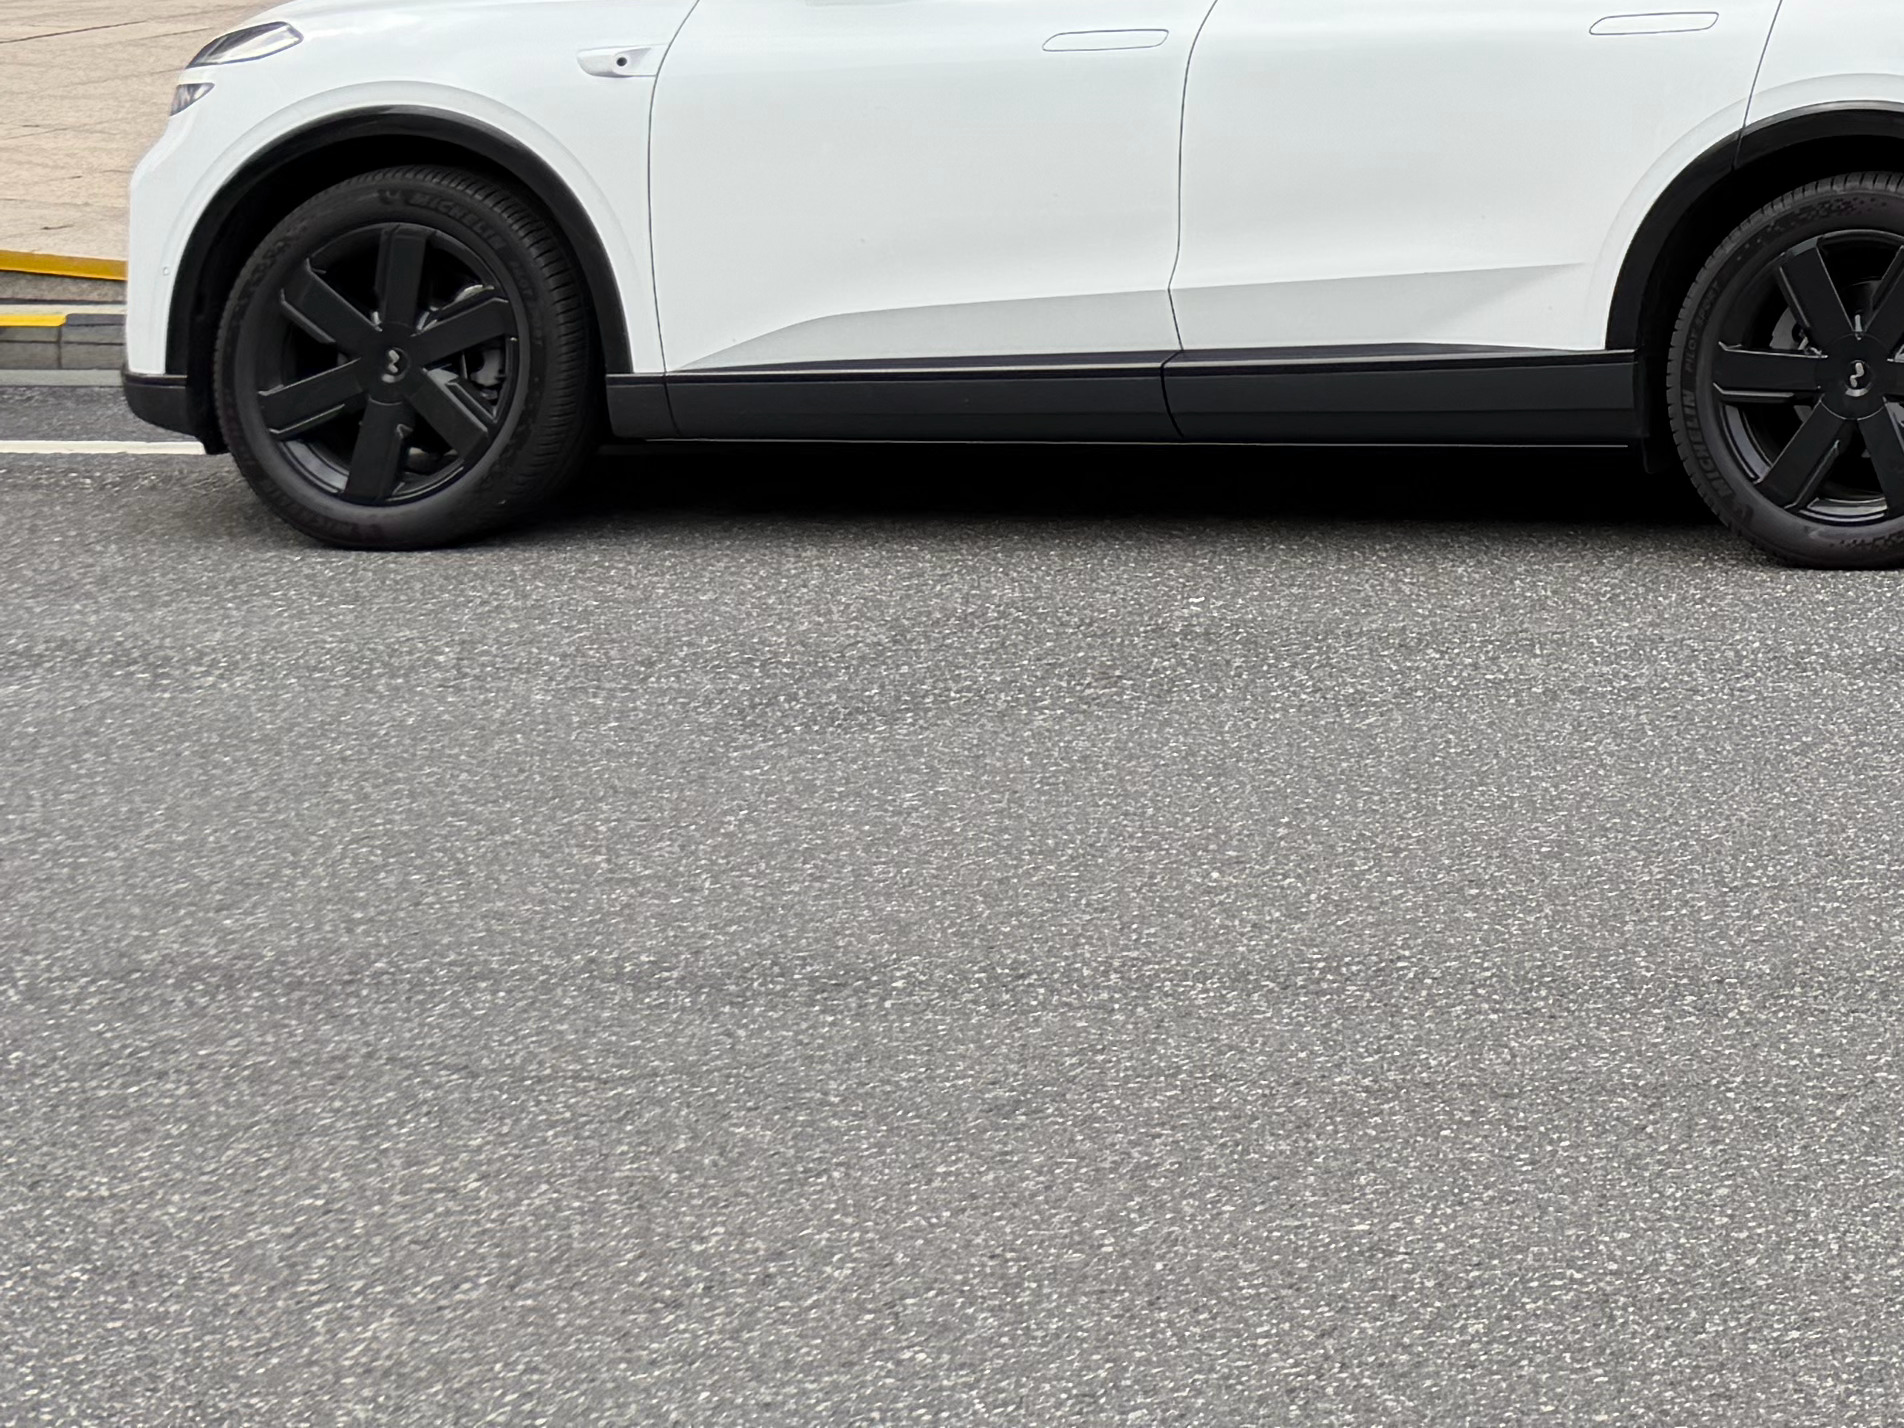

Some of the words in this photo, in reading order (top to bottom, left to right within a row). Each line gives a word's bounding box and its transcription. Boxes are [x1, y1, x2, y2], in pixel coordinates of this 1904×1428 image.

[409, 192, 507, 250] MICHELIN
[1685, 333, 1697, 372] PILOT
[1682, 389, 1734, 498] MICHELIN
